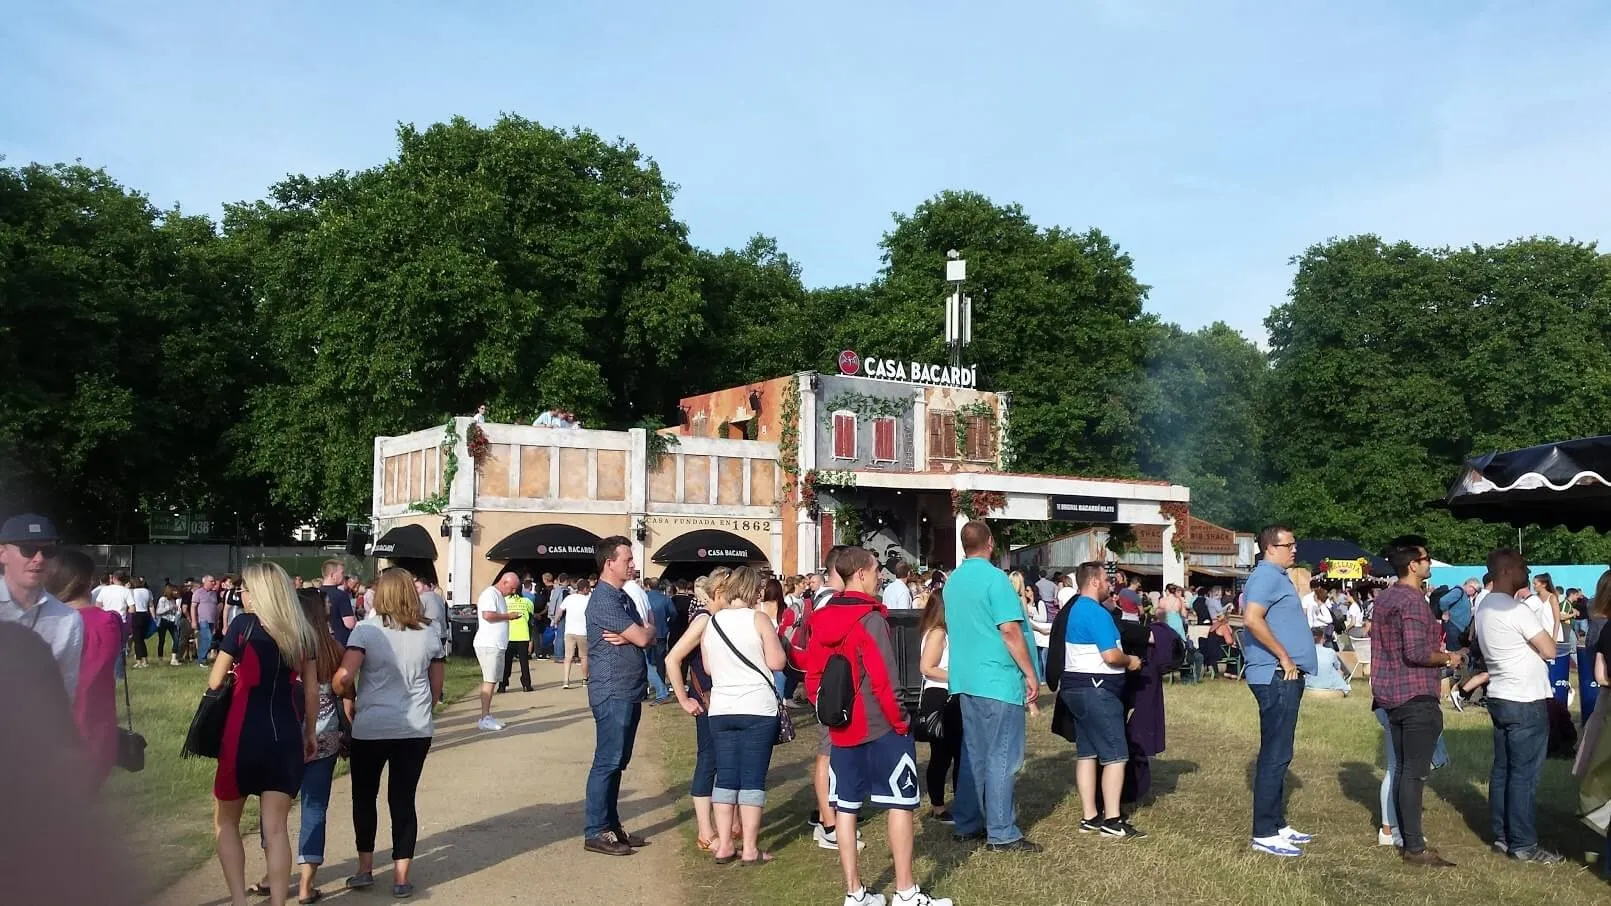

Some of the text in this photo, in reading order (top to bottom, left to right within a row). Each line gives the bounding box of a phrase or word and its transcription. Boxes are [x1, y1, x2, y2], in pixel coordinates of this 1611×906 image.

[864, 357, 977, 387] CASA BACARDÍ
[733, 521, 771, 532] 1862
[548, 545, 567, 553] CASA
[708, 549, 724, 557] CASA
